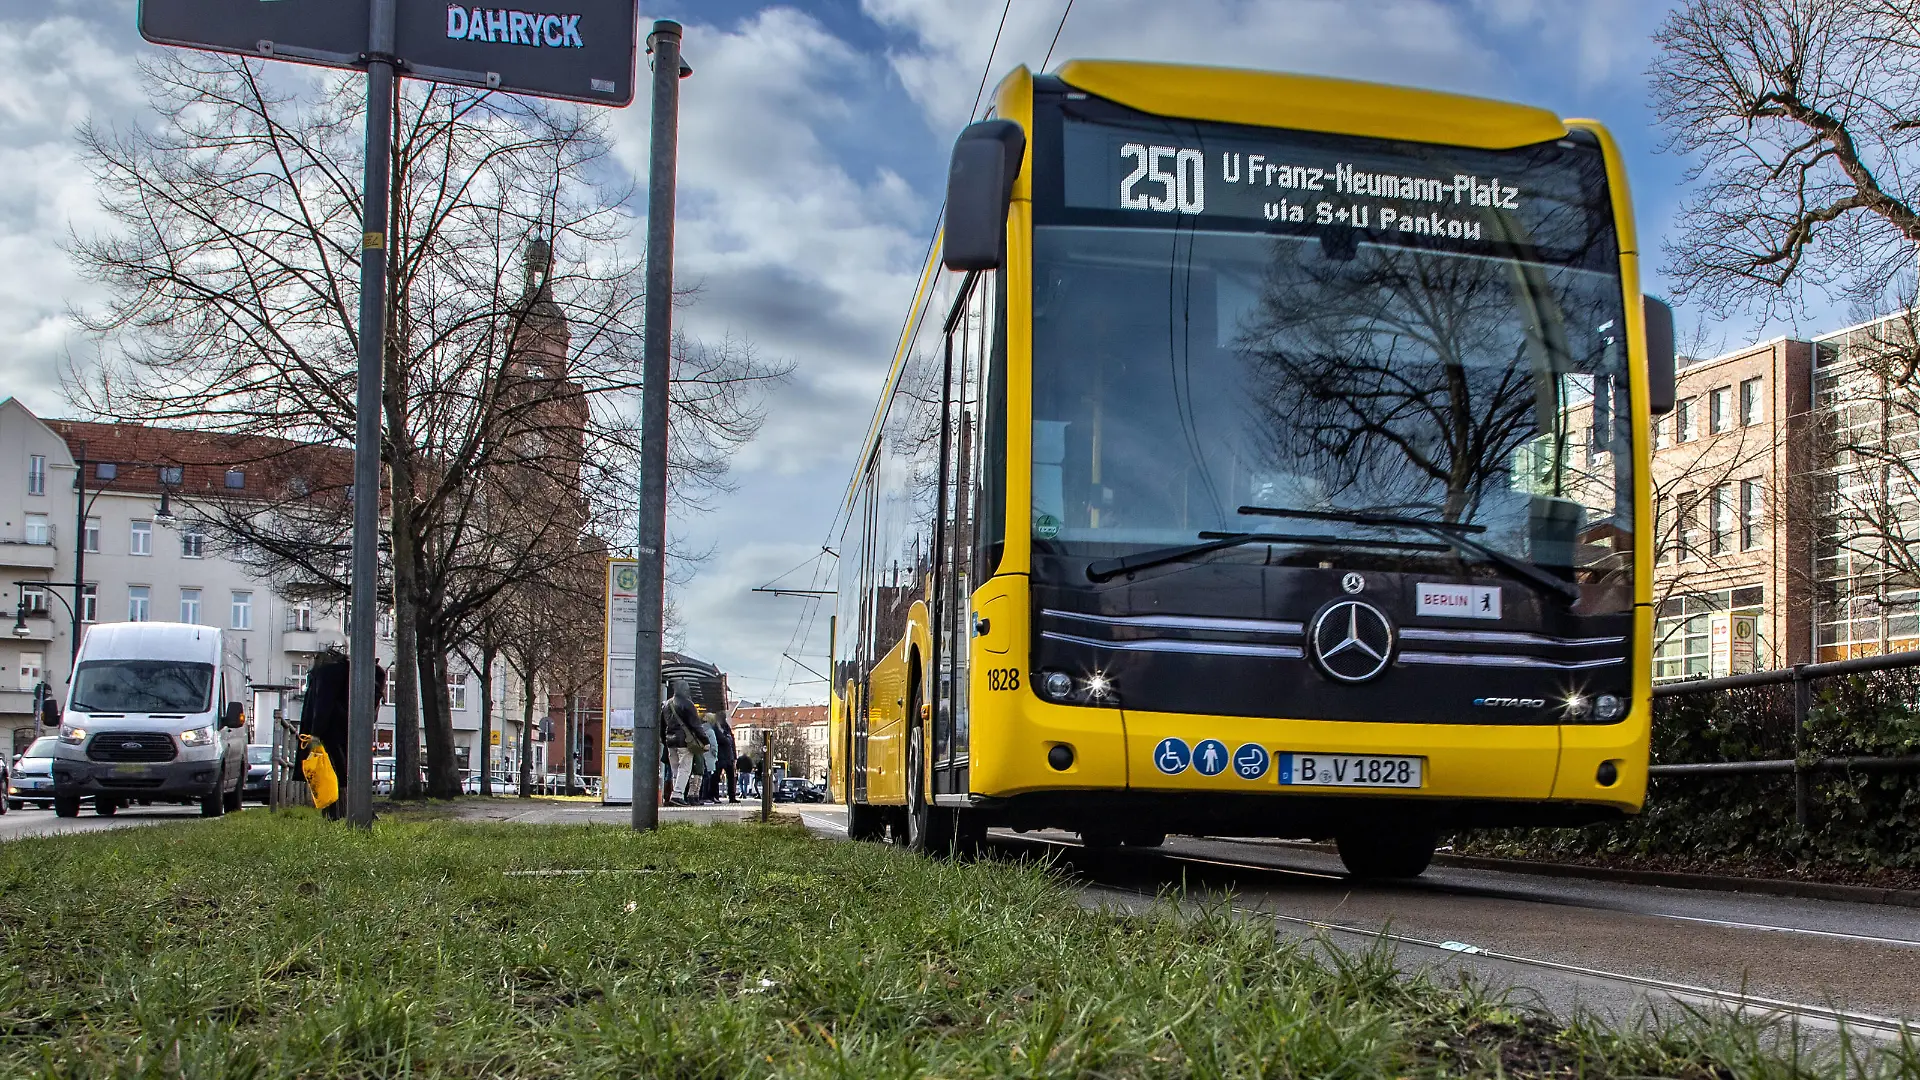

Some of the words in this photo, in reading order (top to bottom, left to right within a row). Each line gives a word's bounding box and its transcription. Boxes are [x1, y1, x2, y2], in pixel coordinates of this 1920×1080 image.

[447, 4, 584, 48] DAHRYCK
[1120, 142, 1205, 215] 250
[1223, 151, 1240, 183] U
[1248, 153, 1519, 210] Franz-Neumann-Platz
[1264, 198, 1304, 223] via
[1316, 201, 1369, 228] S+U
[1380, 207, 1480, 240] Pankow
[1424, 594, 1468, 607] BERLIN
[987, 668, 1020, 691] 1828
[1302, 758, 1316, 781] B
[1334, 758, 1348, 782] V
[1353, 759, 1410, 784] 1828
